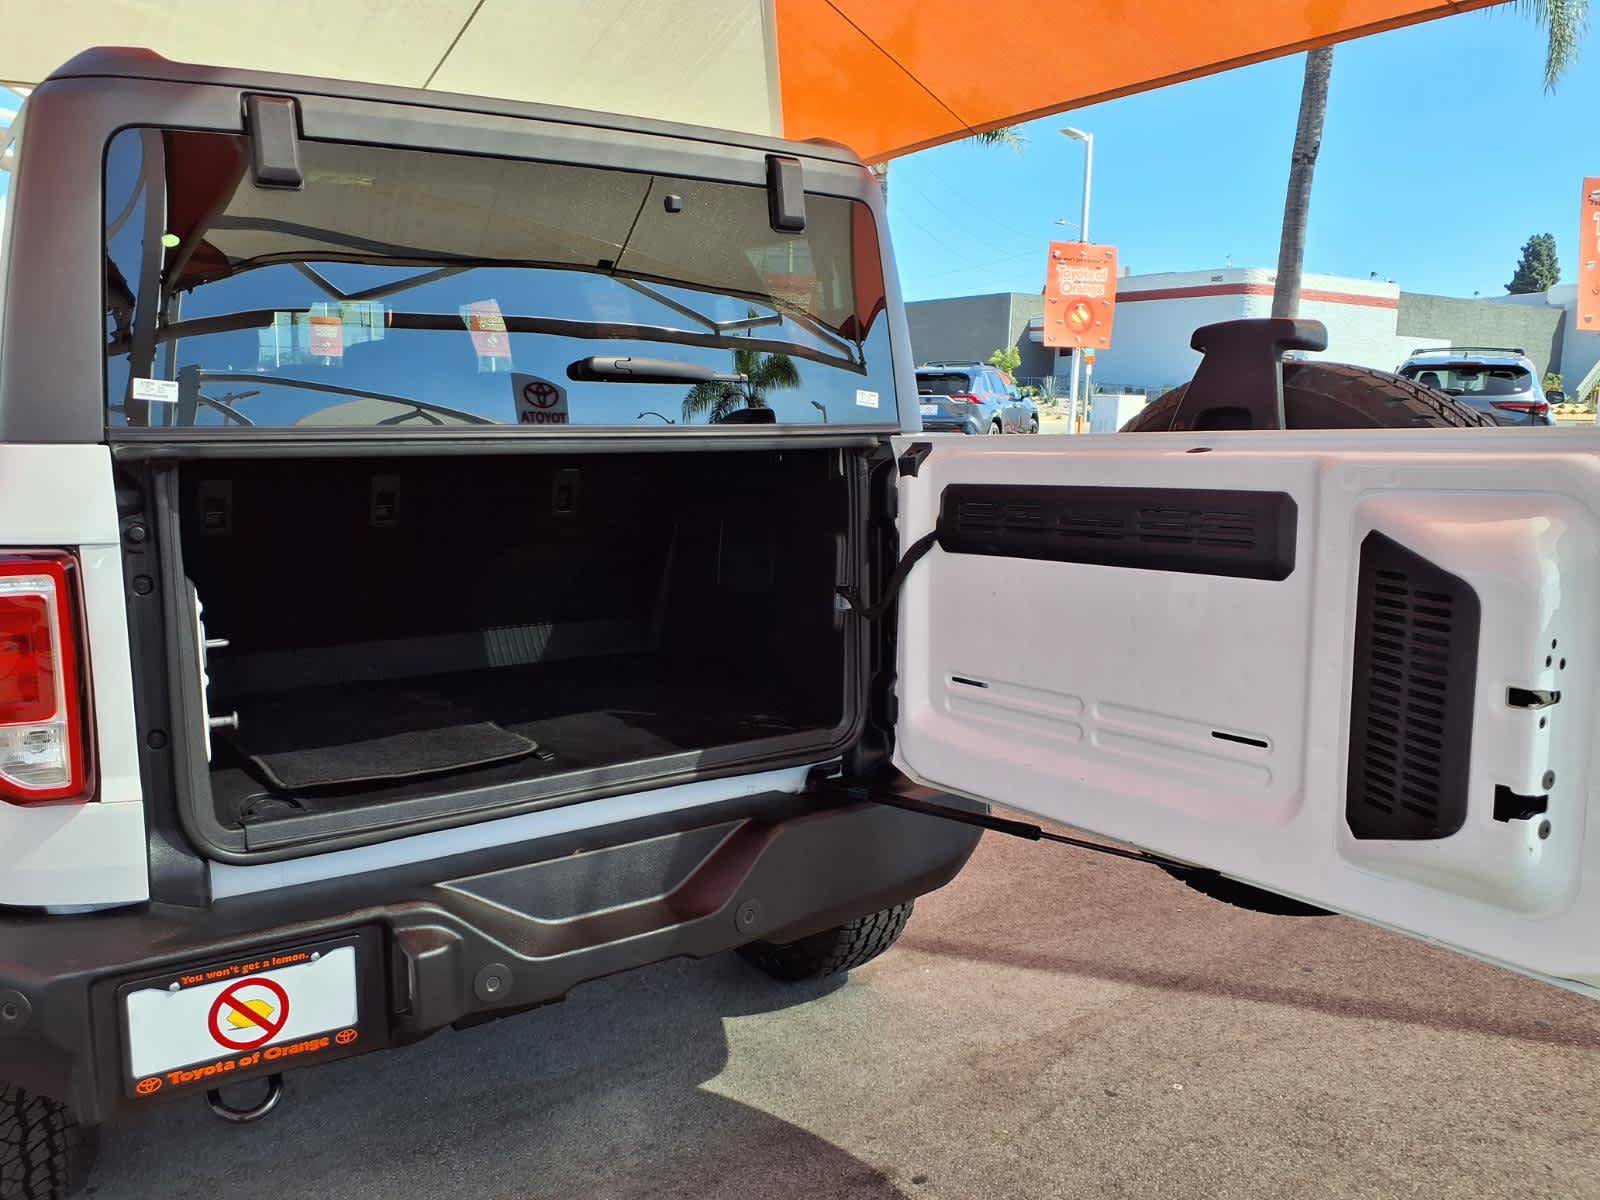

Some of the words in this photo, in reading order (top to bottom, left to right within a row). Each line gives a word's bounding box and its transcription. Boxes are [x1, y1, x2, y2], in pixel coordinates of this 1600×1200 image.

[181, 973, 204, 985] You
[206, 965, 241, 980] won't
[241, 959, 261, 975] get
[262, 958, 271, 968] a
[272, 952, 310, 966] lemon.
[167, 1059, 236, 1085] Toyota
[239, 1051, 261, 1067] of
[263, 1035, 330, 1061] Orange
